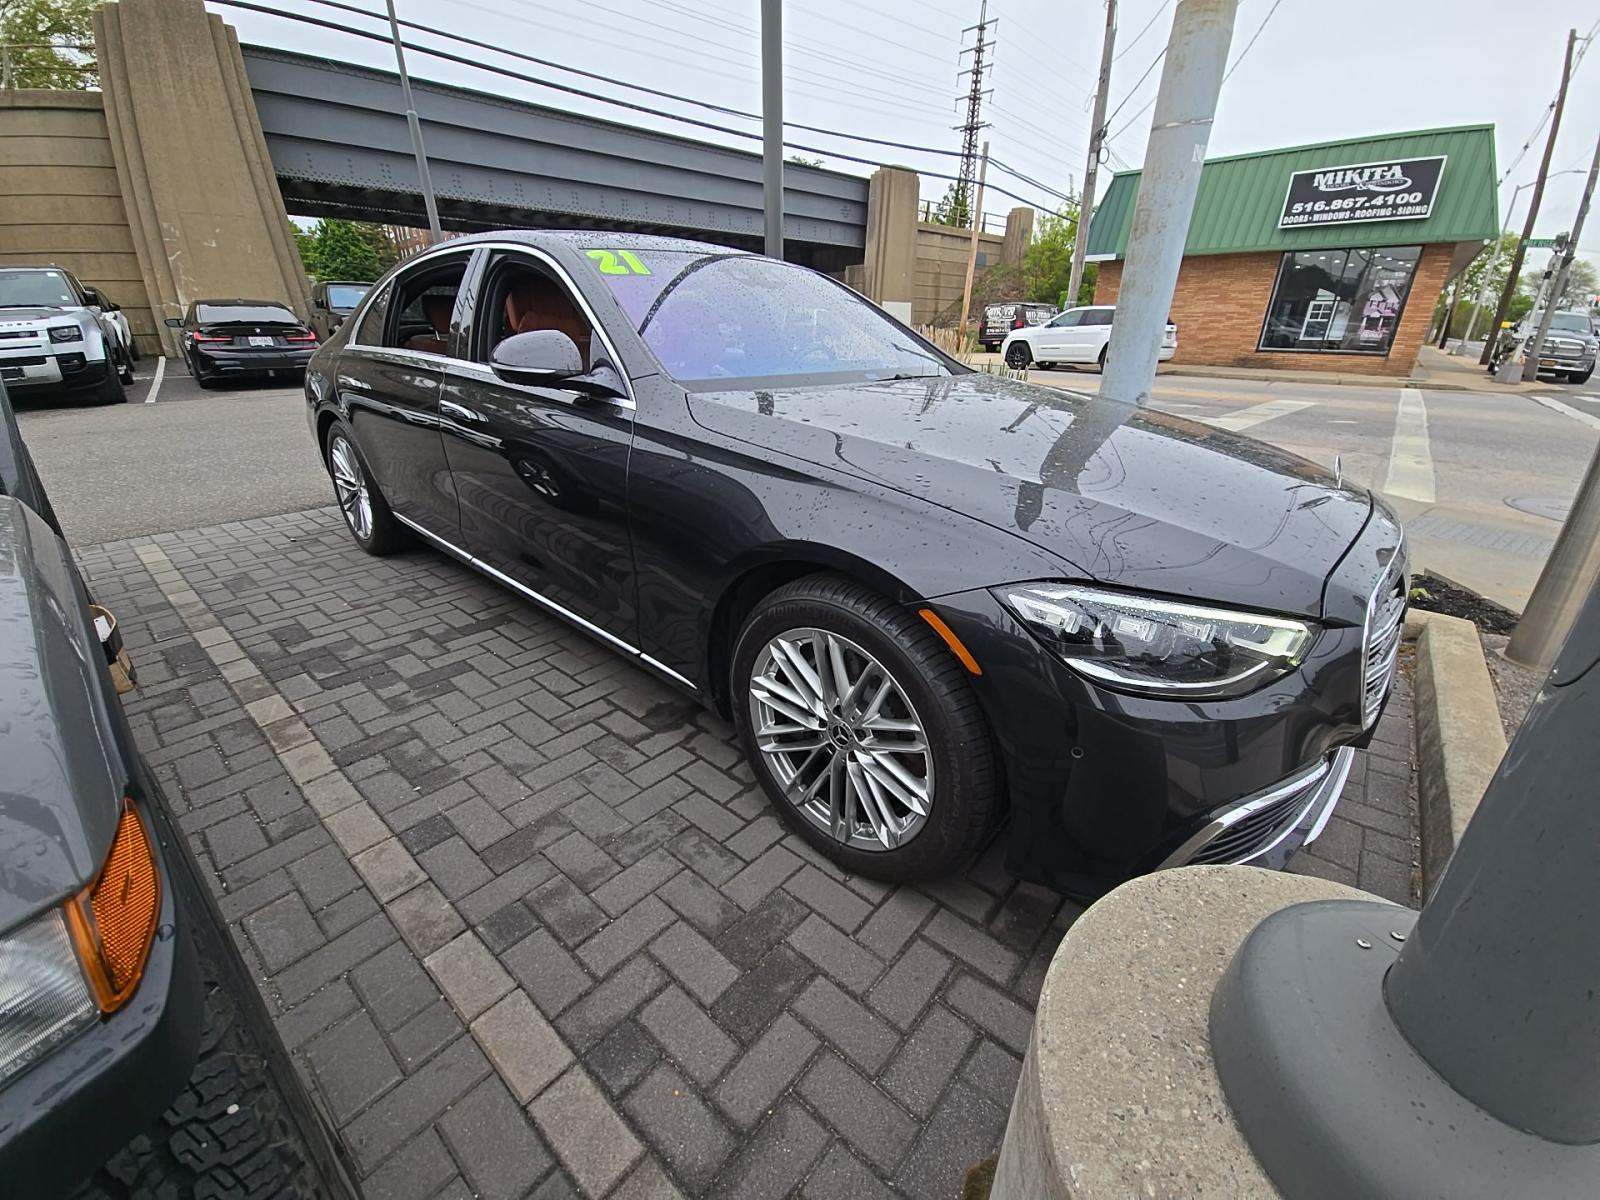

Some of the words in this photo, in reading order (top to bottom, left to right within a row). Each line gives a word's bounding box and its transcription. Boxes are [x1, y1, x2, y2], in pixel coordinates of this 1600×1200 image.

[1313, 165, 1404, 189] MIKITA
[1292, 192, 1423, 213] 516.867.4100
[1283, 214, 1309, 225] DOORS
[1313, 211, 1351, 222] WINDOWS
[1355, 207, 1392, 219] ROOFING
[1397, 204, 1428, 216] SIDING
[585, 249, 652, 275] 21
